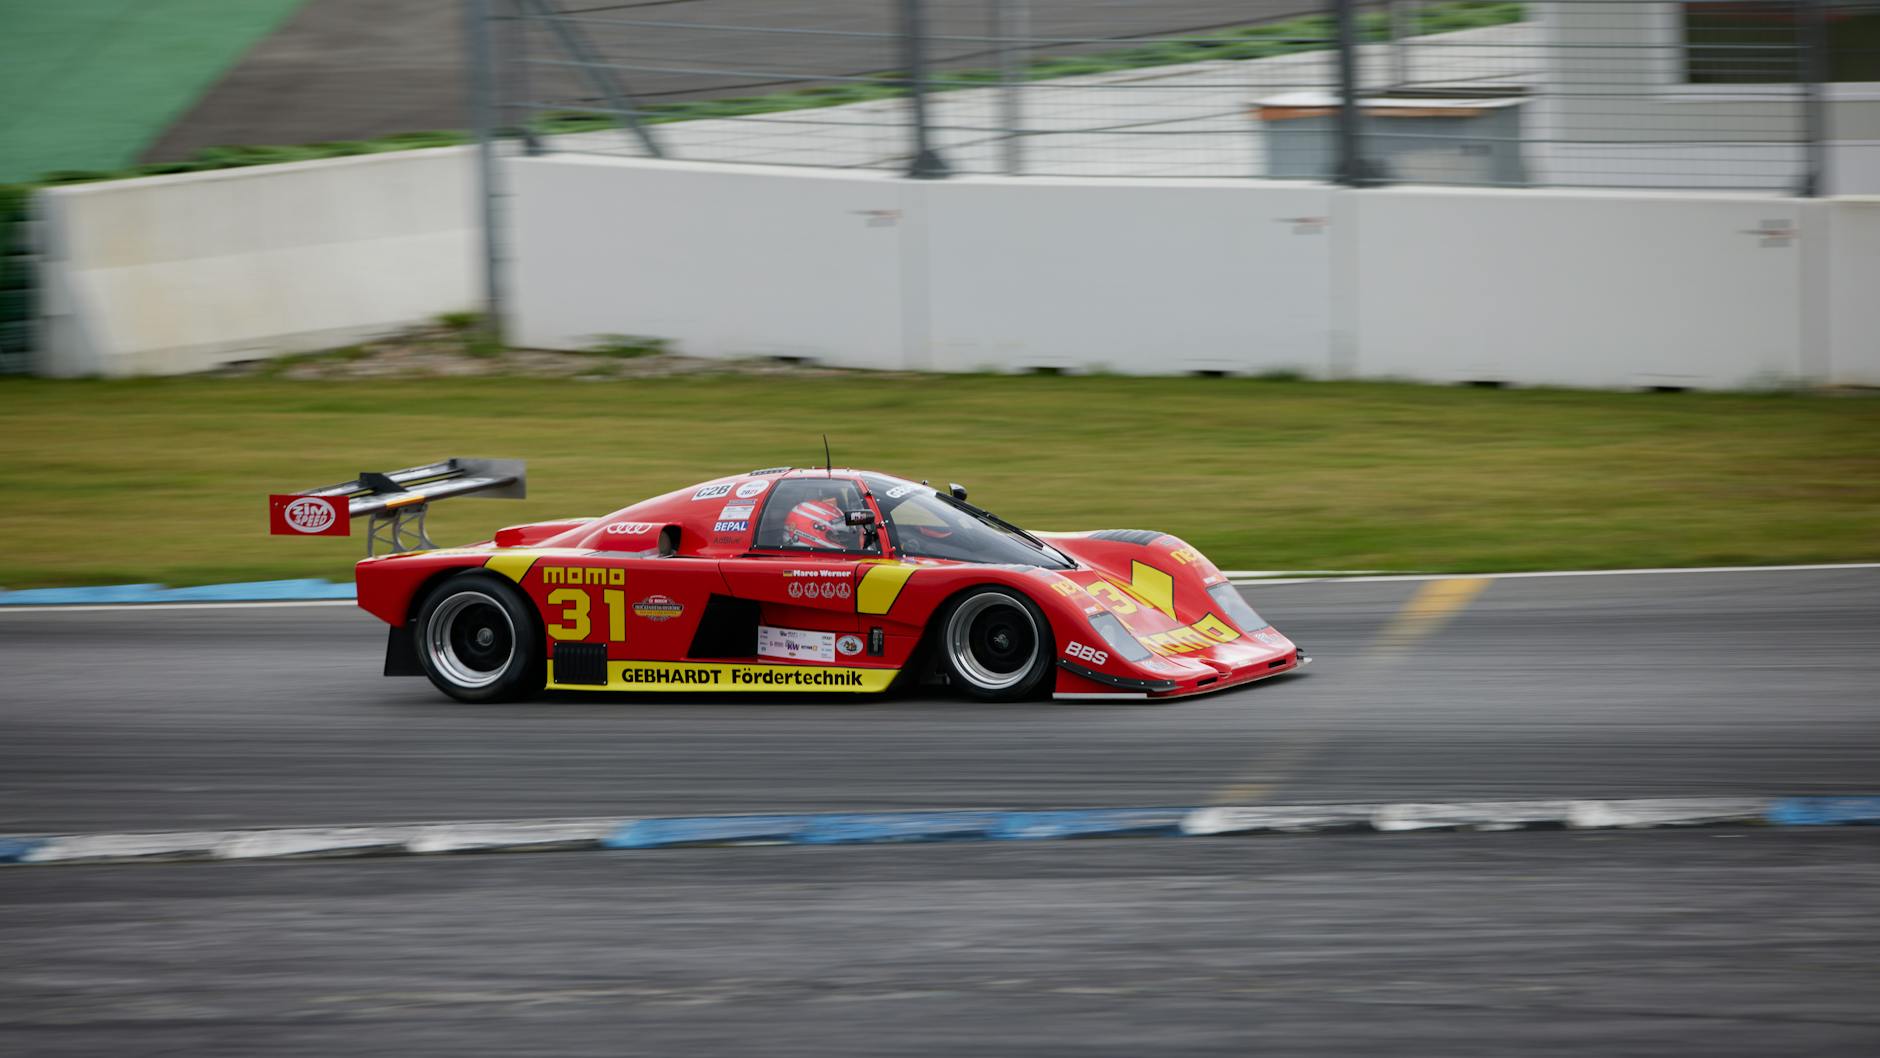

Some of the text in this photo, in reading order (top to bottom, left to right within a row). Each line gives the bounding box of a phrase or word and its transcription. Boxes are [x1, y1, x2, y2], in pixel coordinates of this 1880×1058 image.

[696, 484, 731, 498] C2B
[294, 514, 328, 528] SPEED
[713, 521, 747, 531] BEPAL
[793, 569, 851, 577] Marco Werner
[547, 588, 625, 642] 31
[1065, 641, 1109, 665] BBS
[621, 668, 863, 686] GEBHARDT Fördertechnik
